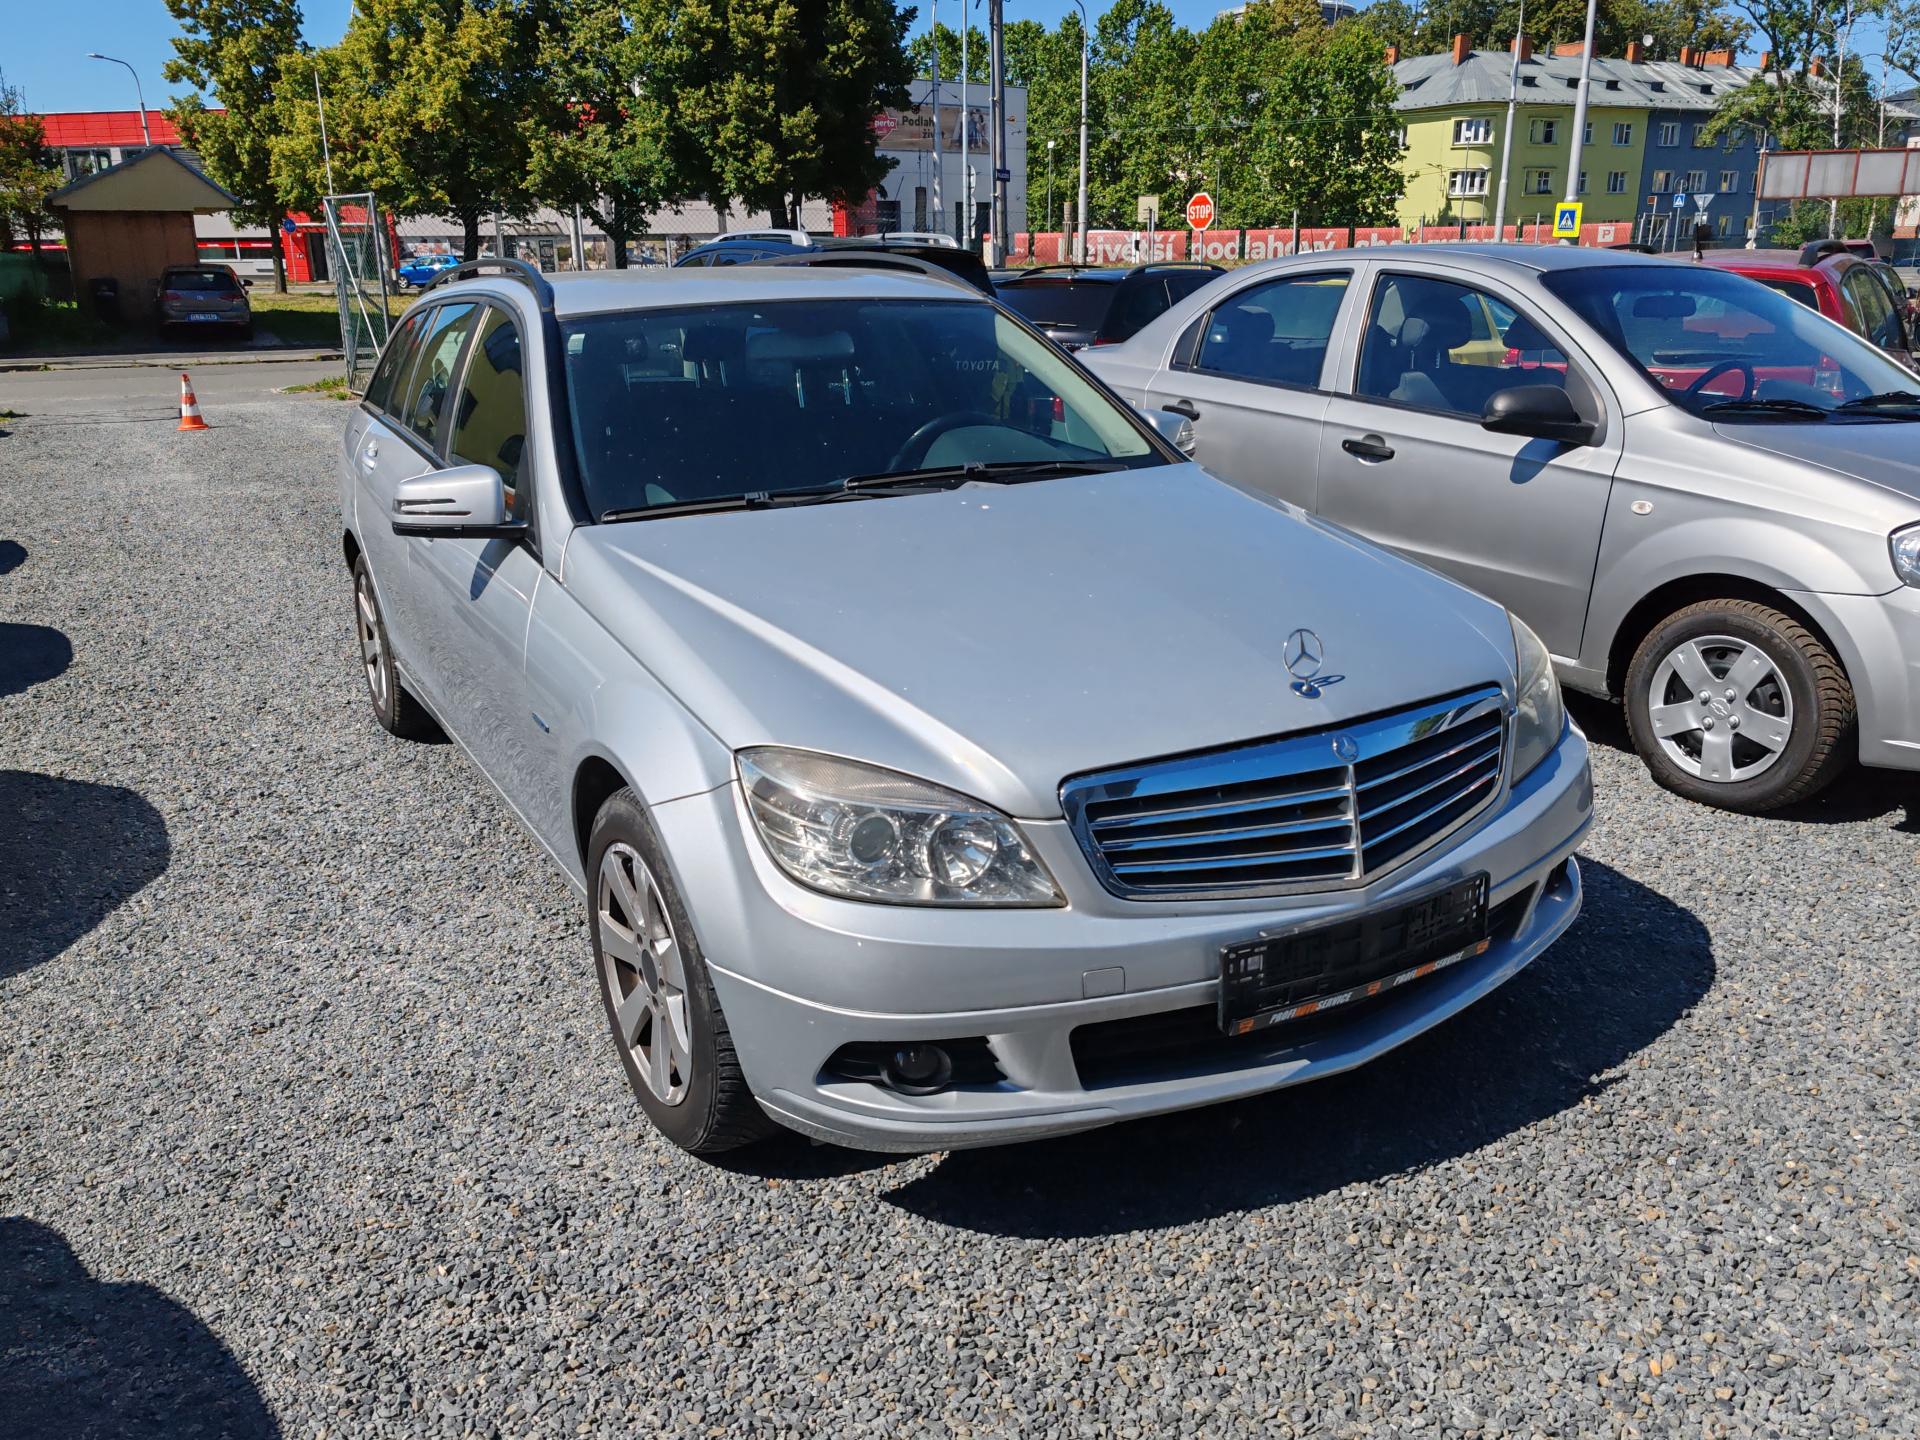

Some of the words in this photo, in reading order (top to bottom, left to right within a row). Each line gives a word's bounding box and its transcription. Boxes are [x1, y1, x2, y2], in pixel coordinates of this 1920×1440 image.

[902, 115, 936, 127] Podlah
[1189, 205, 1212, 220] STOP
[1602, 229, 1611, 239] P
[955, 360, 1000, 371] TOYOTA
